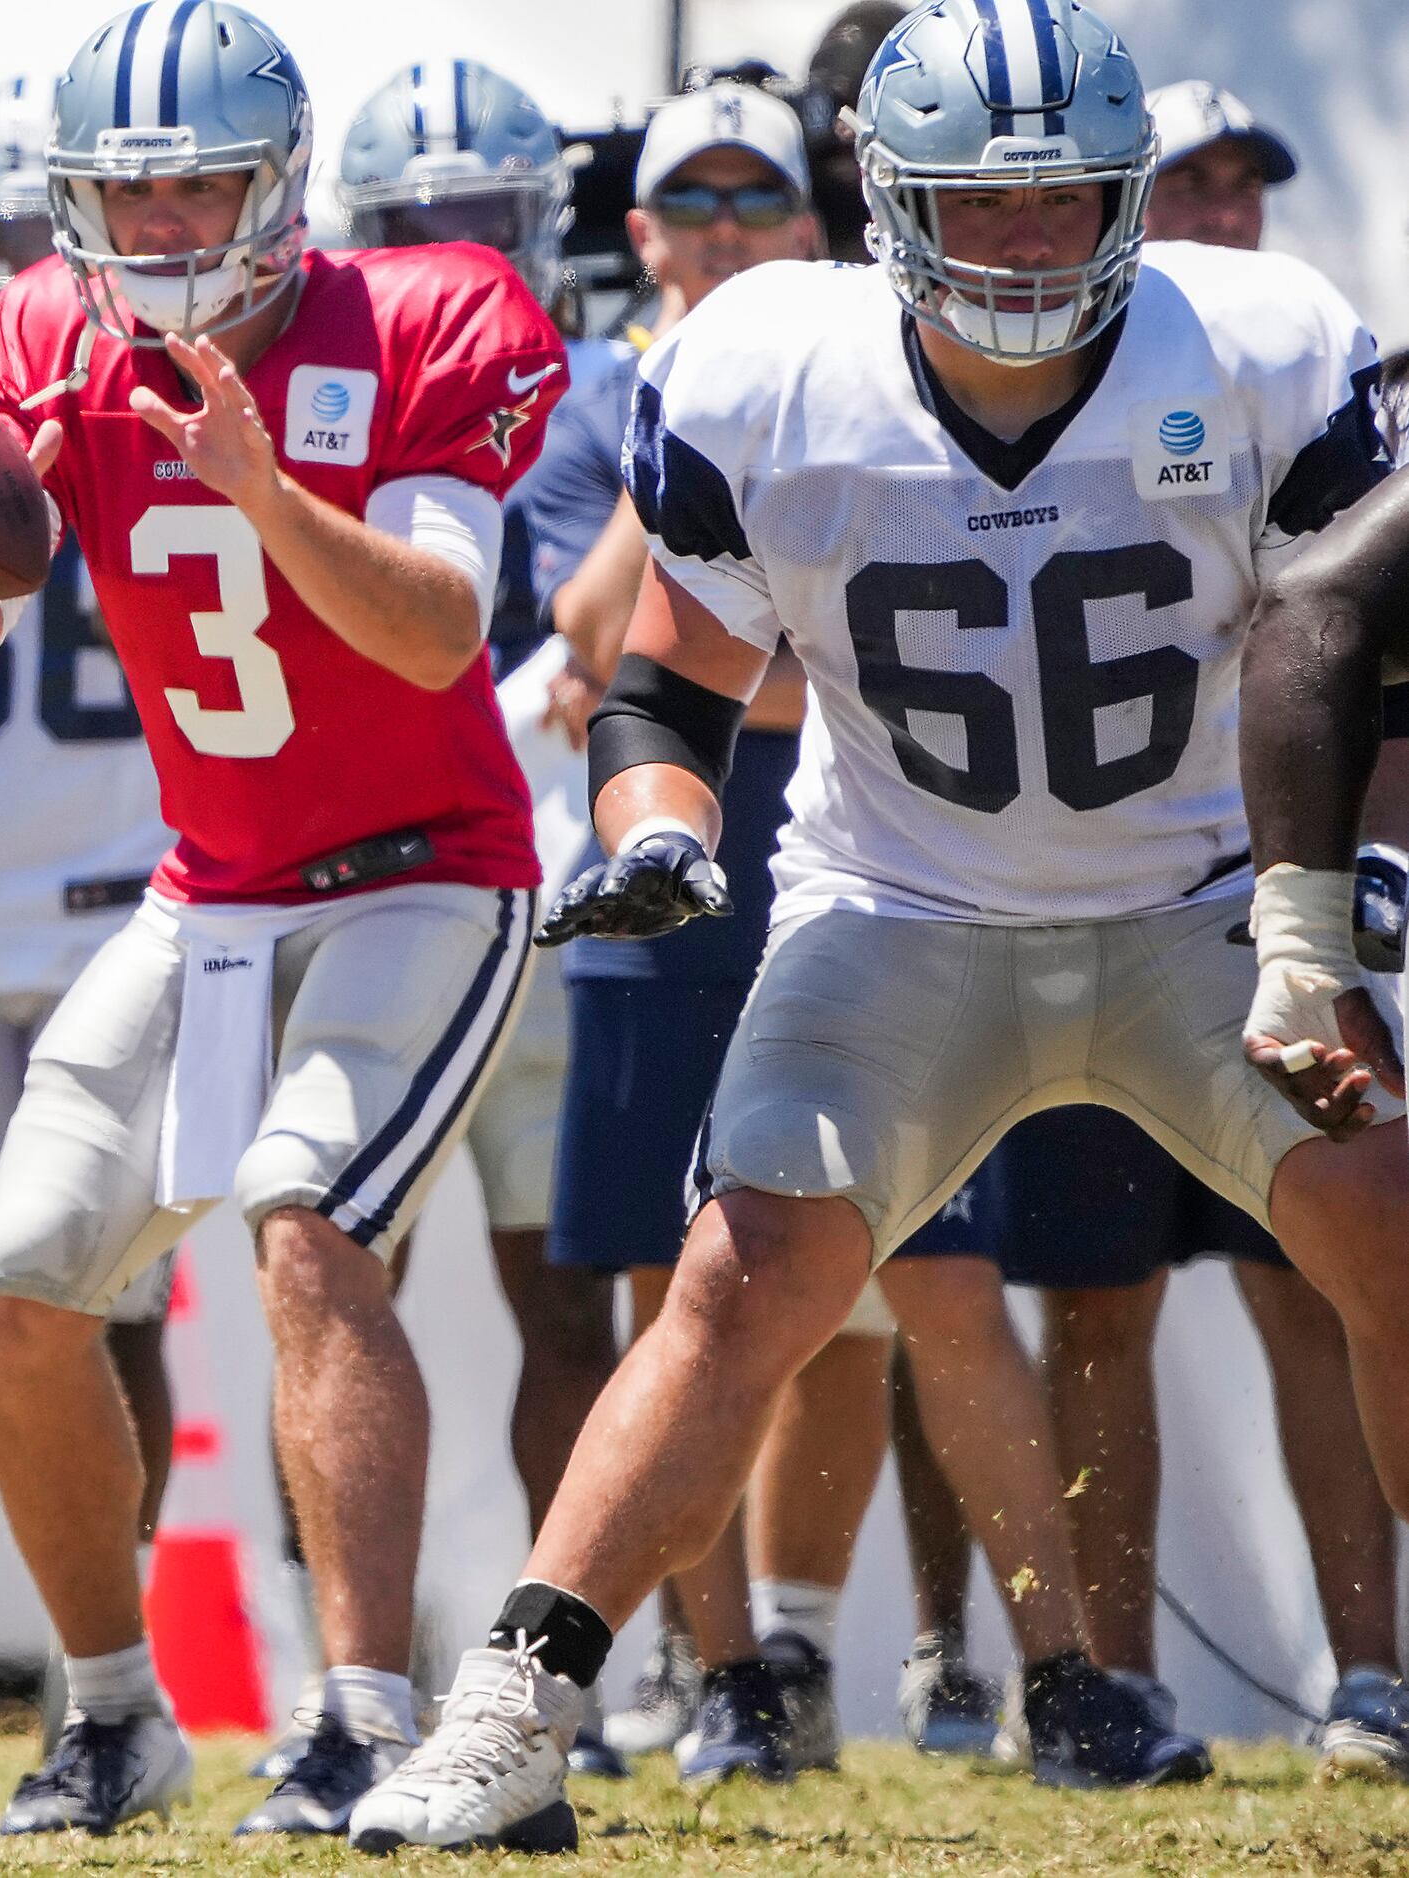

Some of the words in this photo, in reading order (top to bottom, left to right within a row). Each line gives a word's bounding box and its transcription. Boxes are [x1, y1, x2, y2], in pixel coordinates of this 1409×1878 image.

[1003, 149, 1063, 162] COWBOYS
[303, 430, 350, 451] AT&T
[1157, 461, 1214, 485] AT&T
[967, 505, 1059, 532] COWBOYS
[129, 505, 295, 758] 3
[845, 540, 1199, 814] 66
